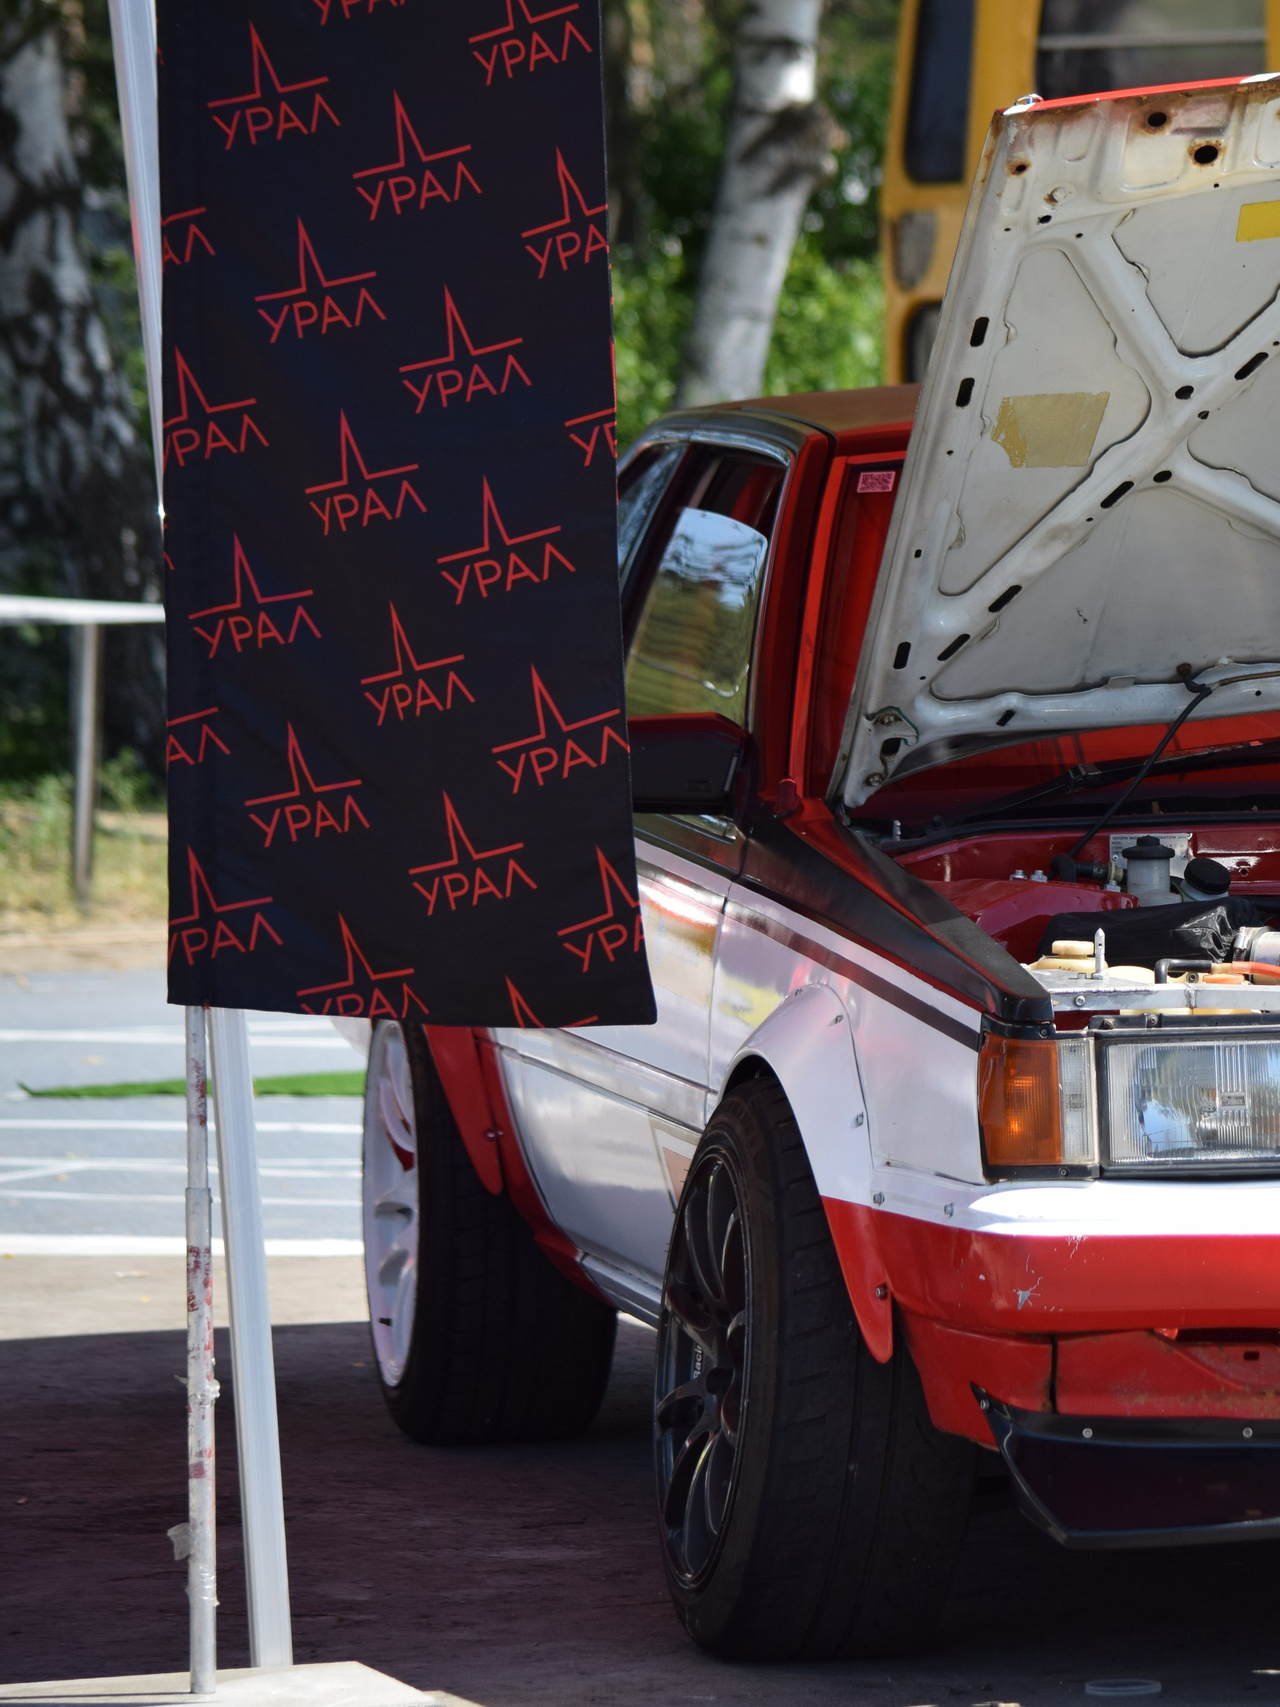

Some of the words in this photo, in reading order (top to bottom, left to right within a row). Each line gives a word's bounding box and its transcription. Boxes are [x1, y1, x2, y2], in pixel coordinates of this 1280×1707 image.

[473, 21, 592, 86] УРАЛ
[212, 93, 341, 150] УРАЛ
[356, 161, 482, 221] УРАЛ
[258, 288, 386, 343] УРАЛ
[403, 354, 532, 414] УРАЛ
[310, 480, 428, 536] УРАЛ
[440, 542, 576, 605] УРАЛ
[193, 605, 322, 659] УРАЛ
[364, 671, 476, 726] УРАЛ
[496, 726, 632, 795] УРАЛ
[249, 794, 371, 849] УРАЛ
[413, 859, 538, 916] УРАЛ
